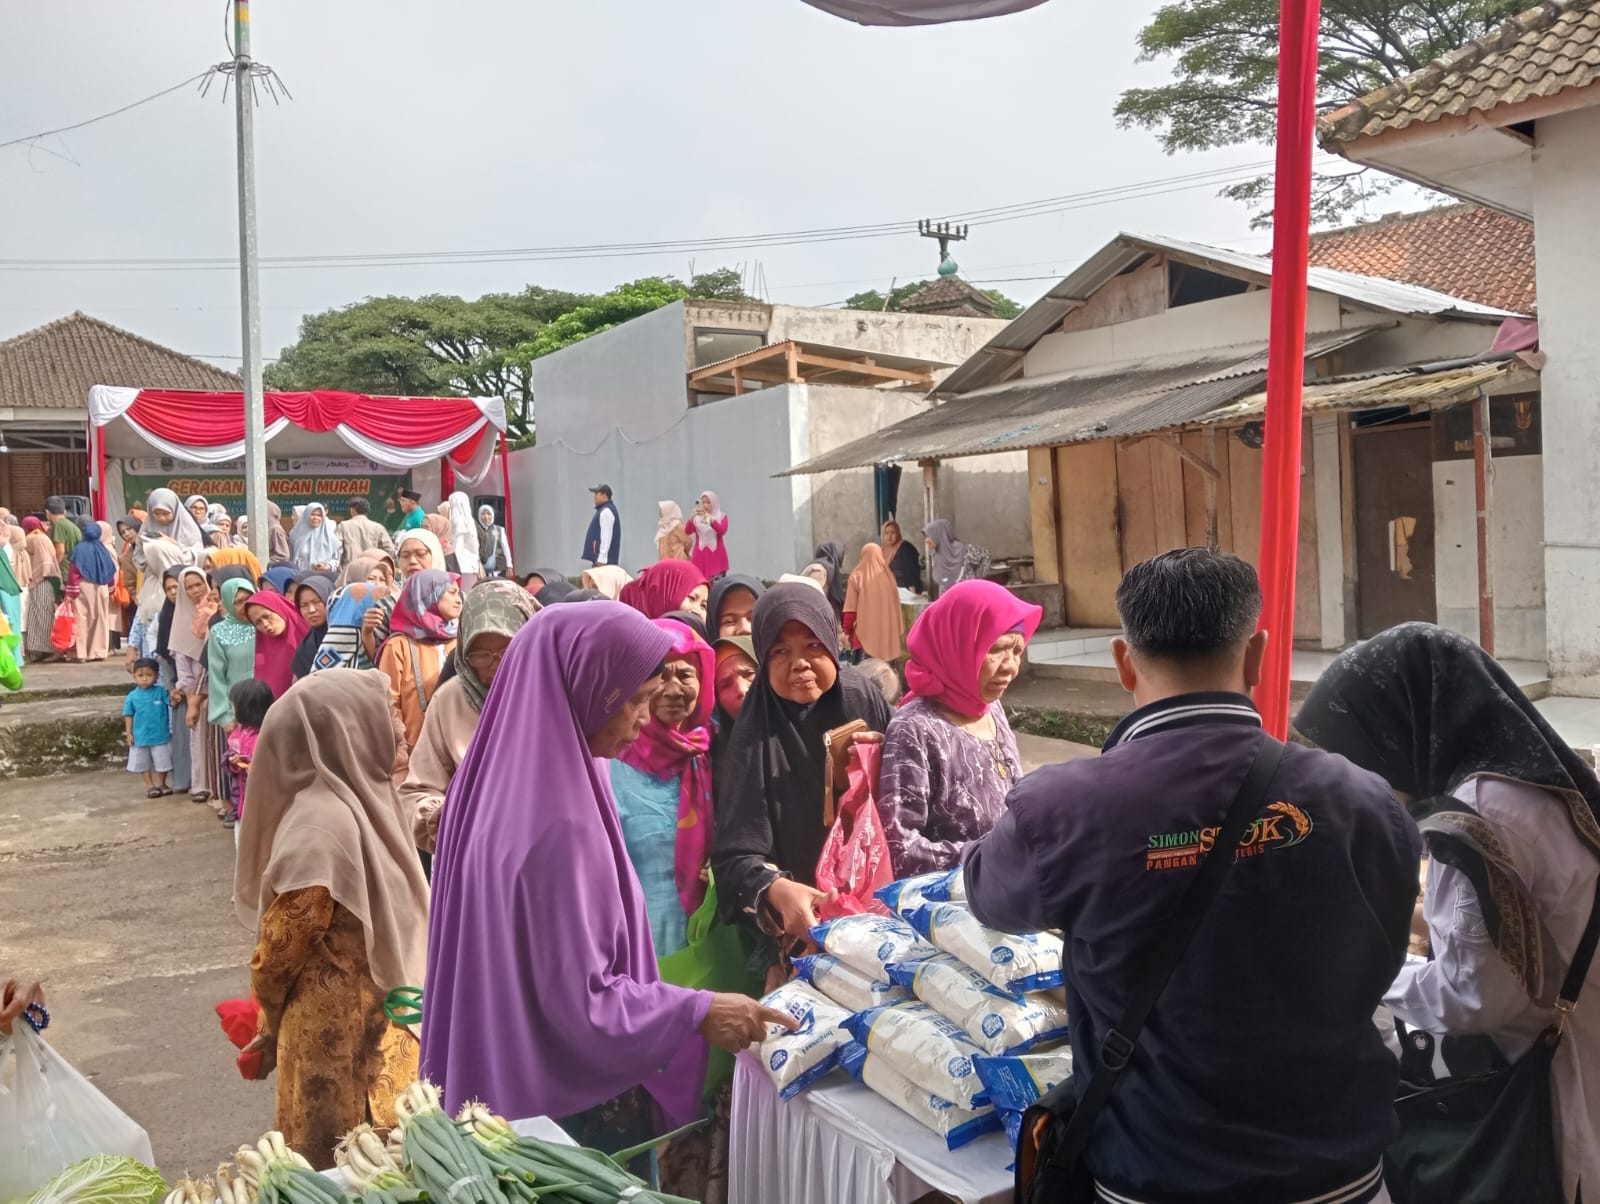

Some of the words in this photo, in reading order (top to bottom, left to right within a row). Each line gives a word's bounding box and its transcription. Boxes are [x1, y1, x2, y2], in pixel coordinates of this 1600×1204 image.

[168, 479, 244, 496] GERAKAN
[269, 478, 313, 496] NGAN
[316, 478, 371, 496] MURAH
[1146, 855, 1198, 871] PANGAN
